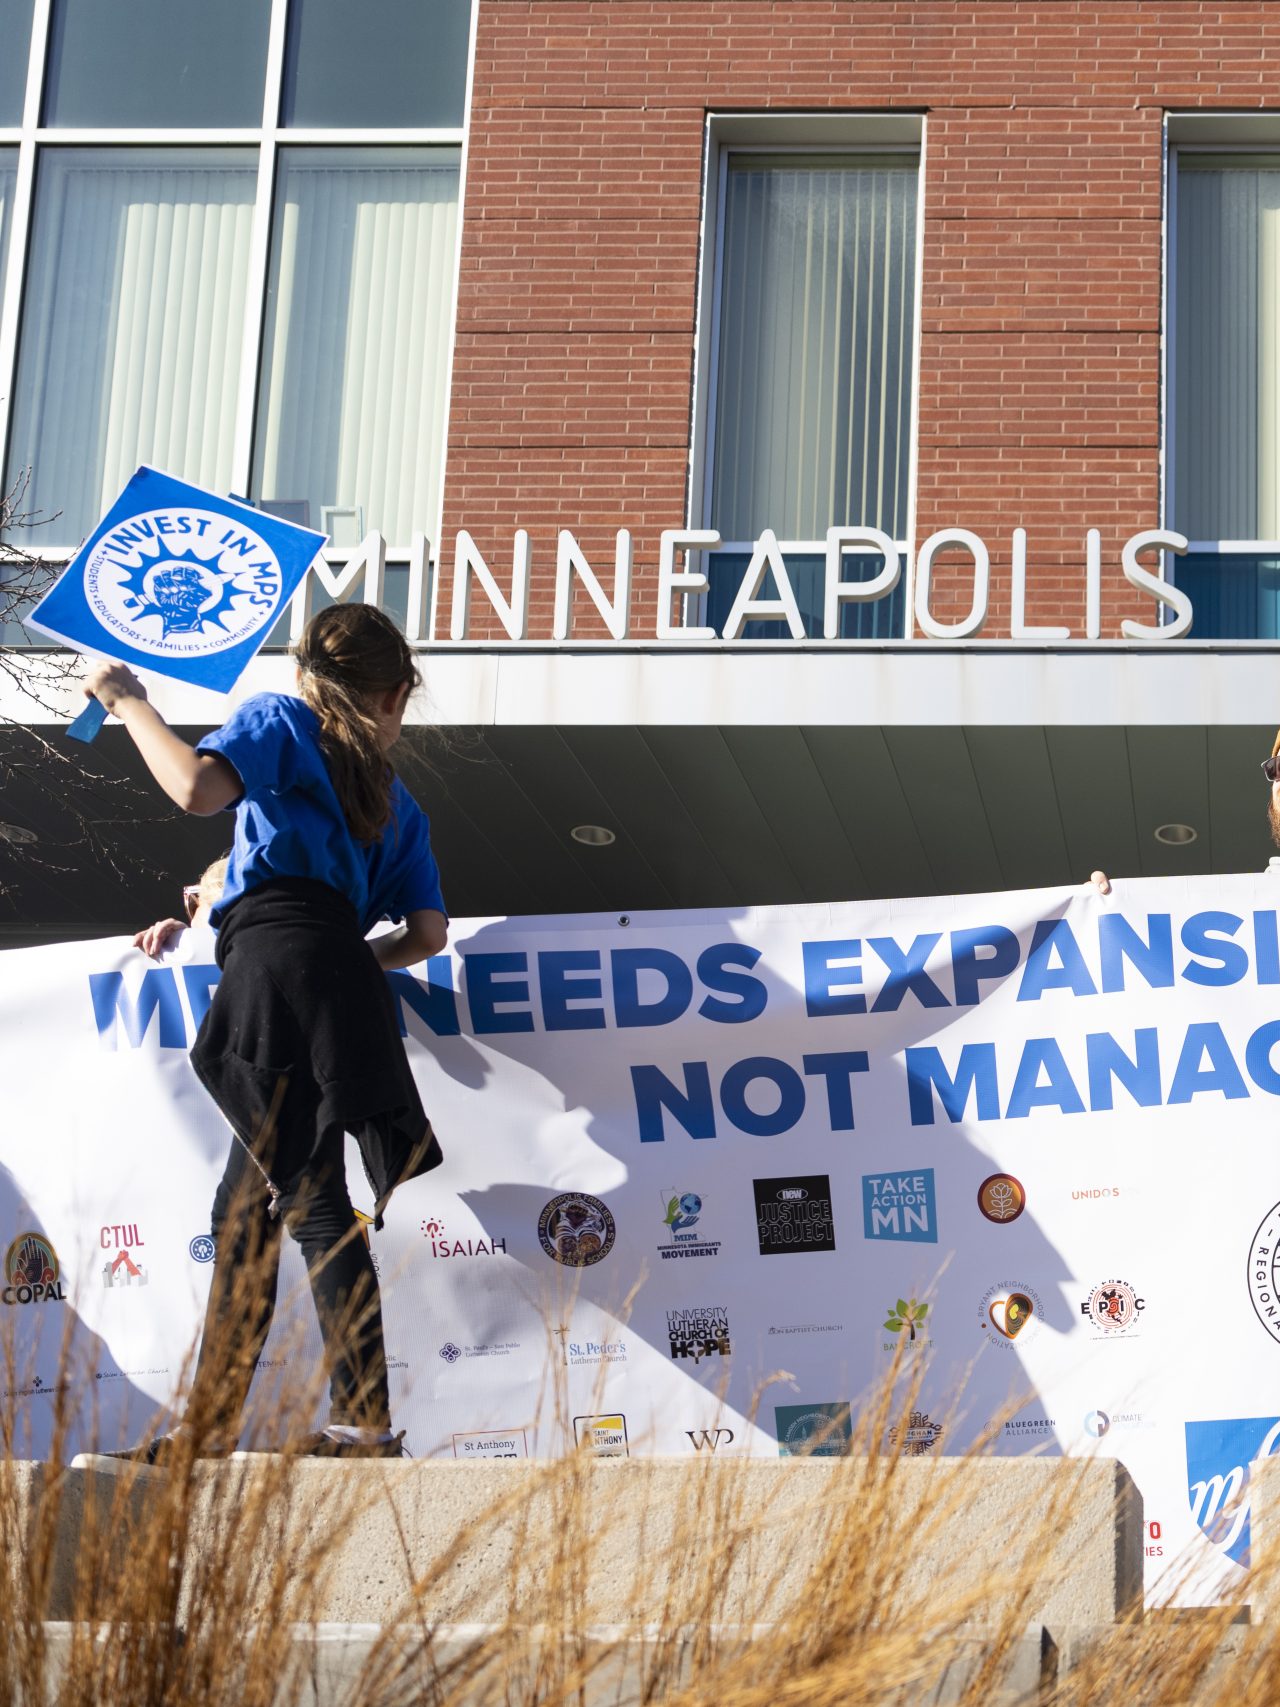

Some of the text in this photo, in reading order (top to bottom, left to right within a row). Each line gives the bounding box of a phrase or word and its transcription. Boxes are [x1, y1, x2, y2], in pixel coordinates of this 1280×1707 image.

[104, 516, 278, 608] INVEST IN MPS
[290, 528, 1193, 640] MINNEAPOLIS
[88, 555, 259, 651] STUDENTS EDUCATORS FAMILIES COMMUNITY
[385, 943, 768, 1039] NEEDS
[630, 1050, 869, 1143] NOT
[869, 1176, 925, 1195] TAKE
[1071, 1187, 1120, 1200] UNIDOS
[871, 1194, 927, 1208] ACTION
[540, 1194, 613, 1228] MINNEAPOLIS FAMILIES
[759, 1199, 831, 1223] JUSTICE
[871, 1205, 929, 1235] MN
[100, 1224, 144, 1249] CTUL
[758, 1220, 834, 1245] PROJECT
[432, 1238, 507, 1258] ISAIAH
[540, 1237, 556, 1256] FOR
[588, 1232, 614, 1264] SCHOOLS
[661, 1248, 718, 1259] MOVEMENT
[1, 1282, 67, 1305] COPAL
[978, 1287, 996, 1317] BRYANT
[665, 1307, 728, 1321] UNIVERSITY
[668, 1318, 729, 1332] LUTHERAN
[668, 1328, 729, 1342] CHURCH OF
[569, 1343, 585, 1356] St.
[670, 1338, 731, 1359] HOPE
[884, 1340, 933, 1351] BACROT
[571, 1356, 602, 1365] Lutheran
[1005, 1420, 1056, 1429] BLUEGREEN
[1113, 1413, 1143, 1423] CLIMATE
[591, 1435, 623, 1446] NTHONY
[1006, 1427, 1048, 1436] ALLIANCE
[464, 1440, 516, 1452] St Anthony
